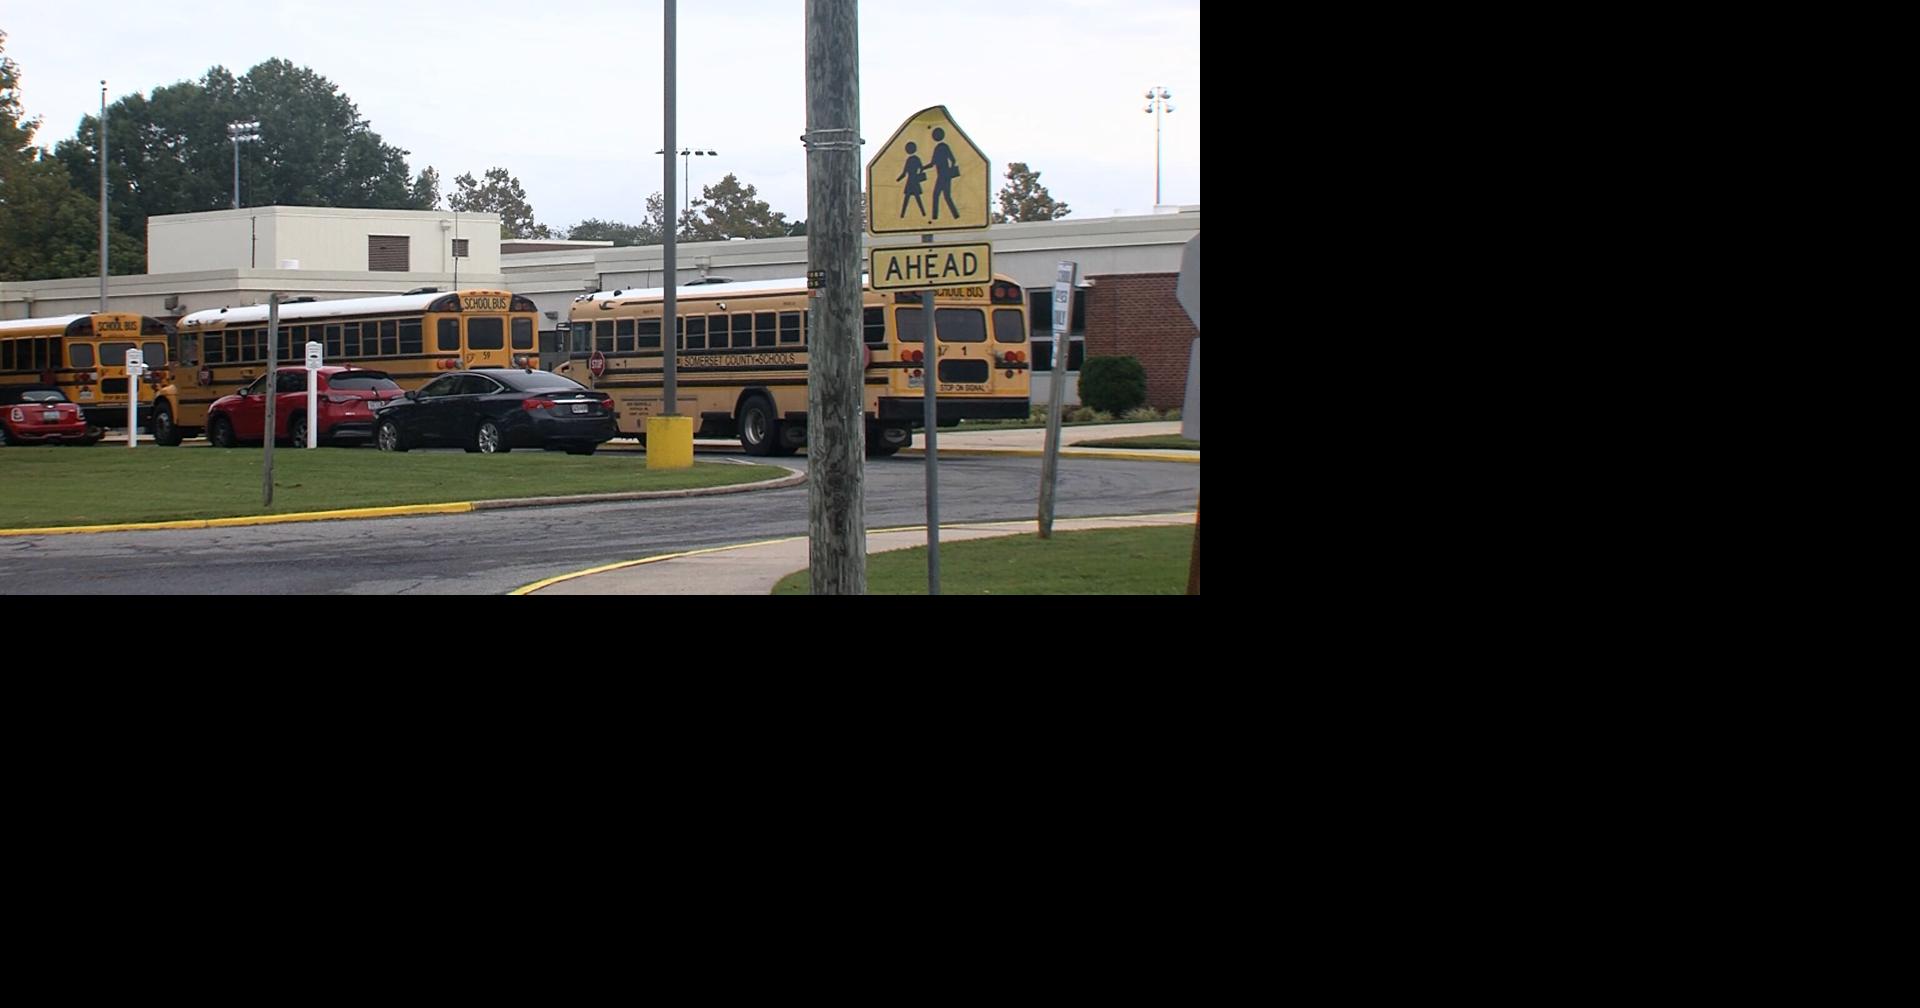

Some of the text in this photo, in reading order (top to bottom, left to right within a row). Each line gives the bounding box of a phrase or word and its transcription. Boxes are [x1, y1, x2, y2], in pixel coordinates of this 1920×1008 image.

[885, 252, 978, 281] AHEAD
[966, 285, 984, 298] BUS
[464, 297, 507, 310] SCHOOL BUS
[98, 321, 137, 331] SCHOOL BUS
[482, 351, 491, 360] 59
[961, 345, 967, 356] 1
[591, 359, 603, 369] STOP
[684, 353, 796, 367] SOMERSET COUNTY SCHOOLS
[940, 384, 985, 392] STOP ON SIGNAL
